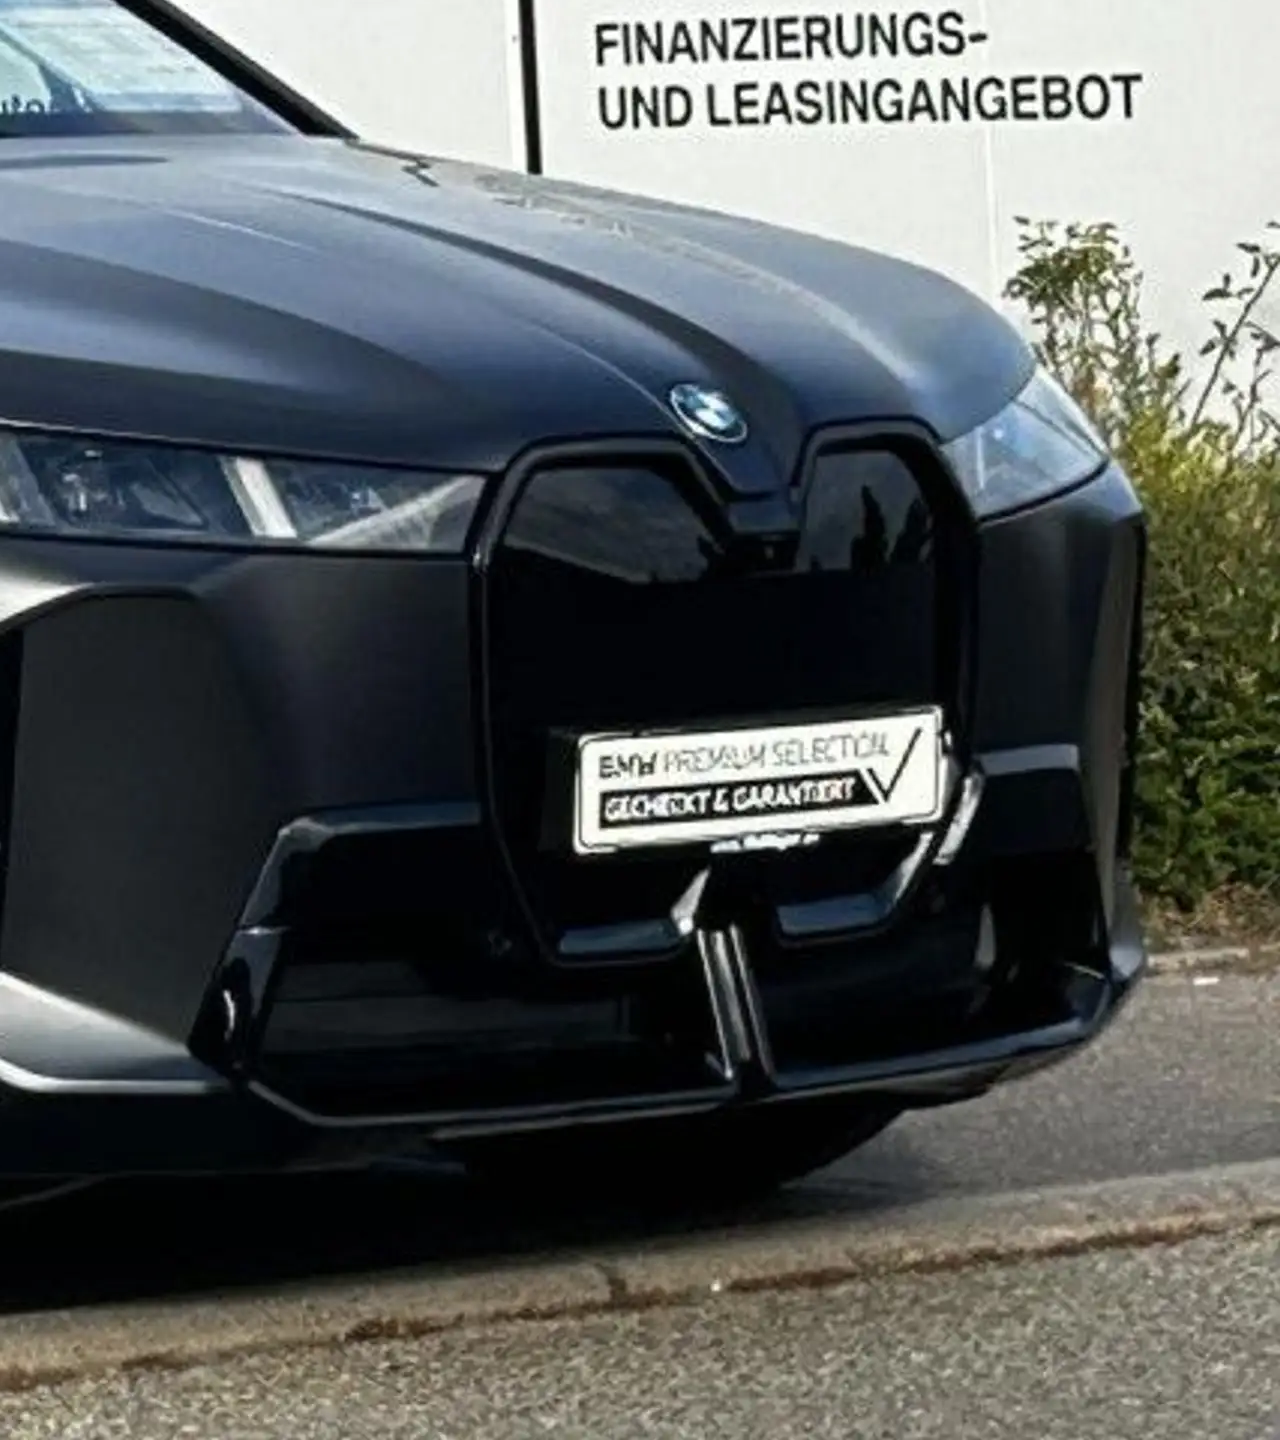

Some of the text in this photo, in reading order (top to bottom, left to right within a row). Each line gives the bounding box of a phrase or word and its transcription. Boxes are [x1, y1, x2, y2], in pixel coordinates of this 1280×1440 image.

[595, 11, 988, 66] FINANZIERUNGS-
[598, 74, 1143, 130] UND LEASINGANGEBOT
